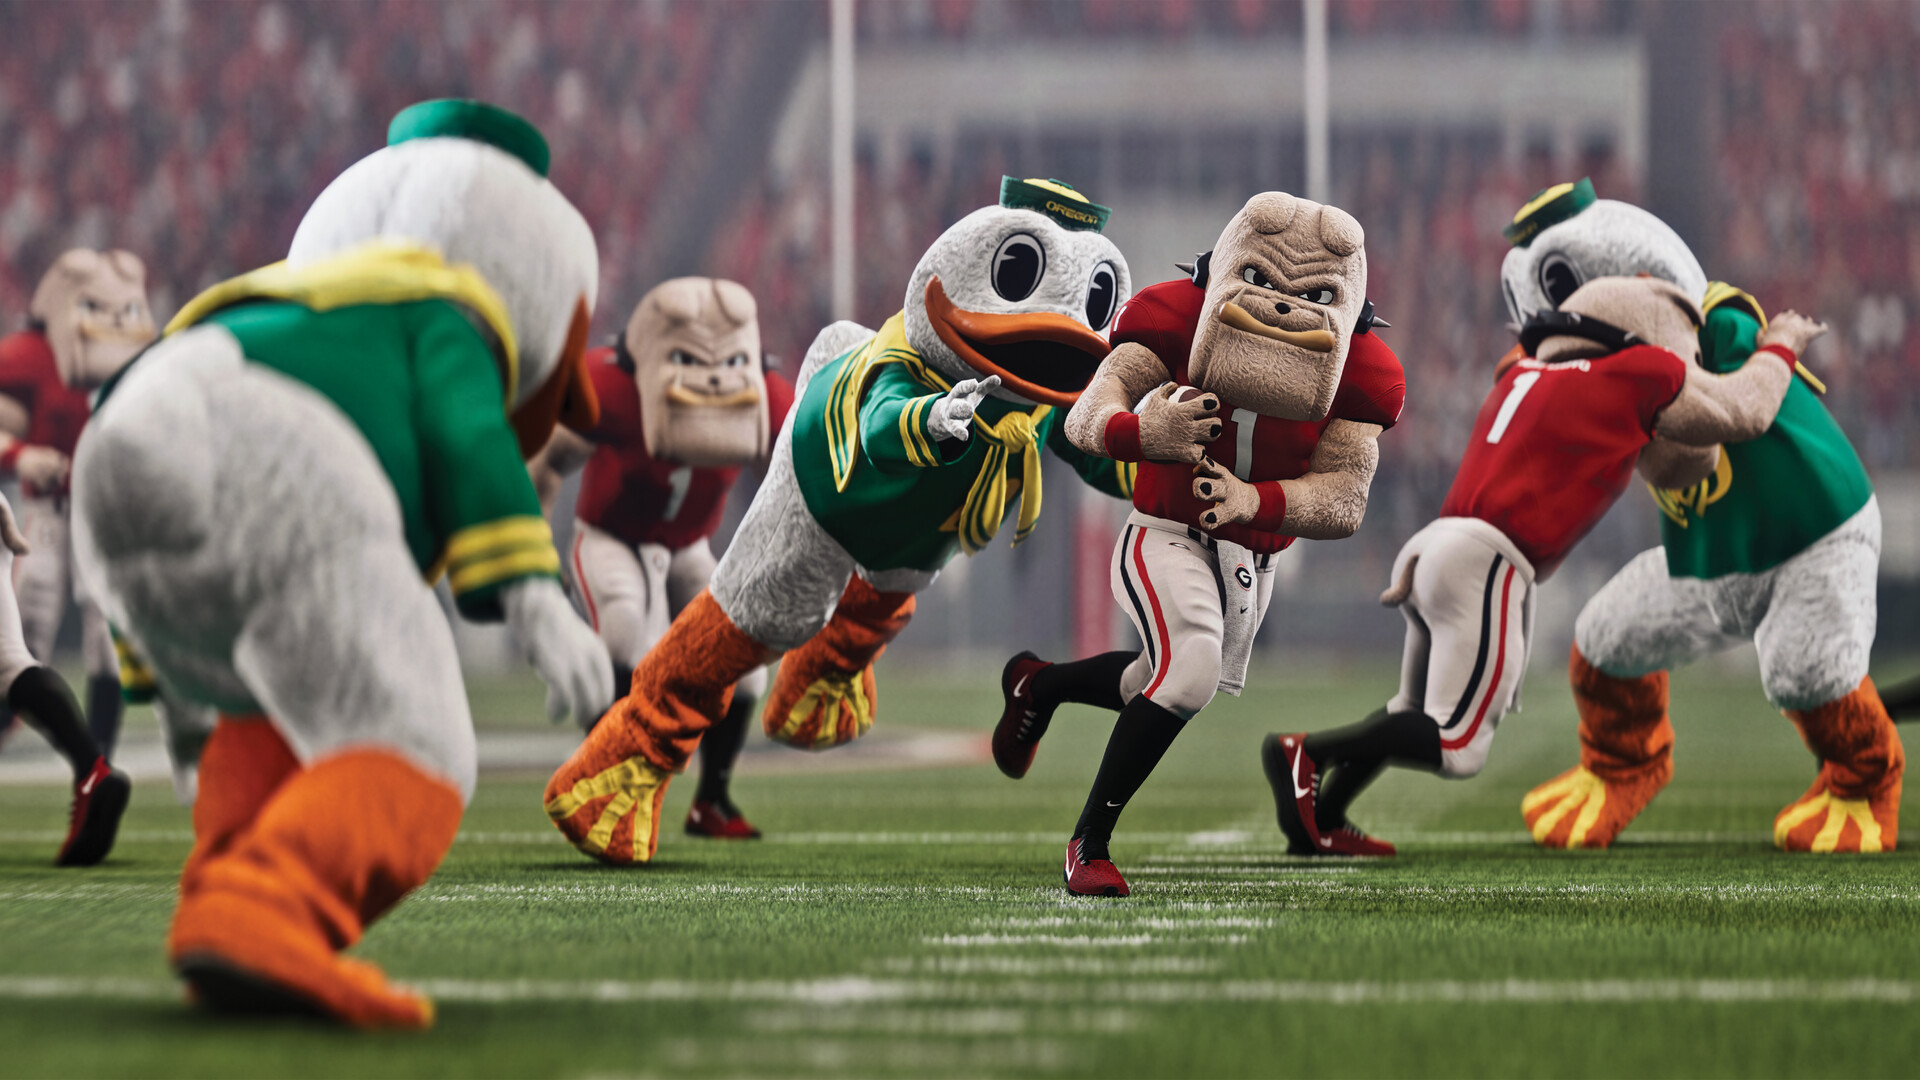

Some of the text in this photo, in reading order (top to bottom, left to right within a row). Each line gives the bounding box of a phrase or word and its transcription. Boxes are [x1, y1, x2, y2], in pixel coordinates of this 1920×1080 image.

[1046, 200, 1098, 225] OREGON
[1486, 371, 1541, 444] 1
[1230, 408, 1258, 482] 1
[663, 467, 692, 522] 1
[1234, 565, 1252, 590] G
